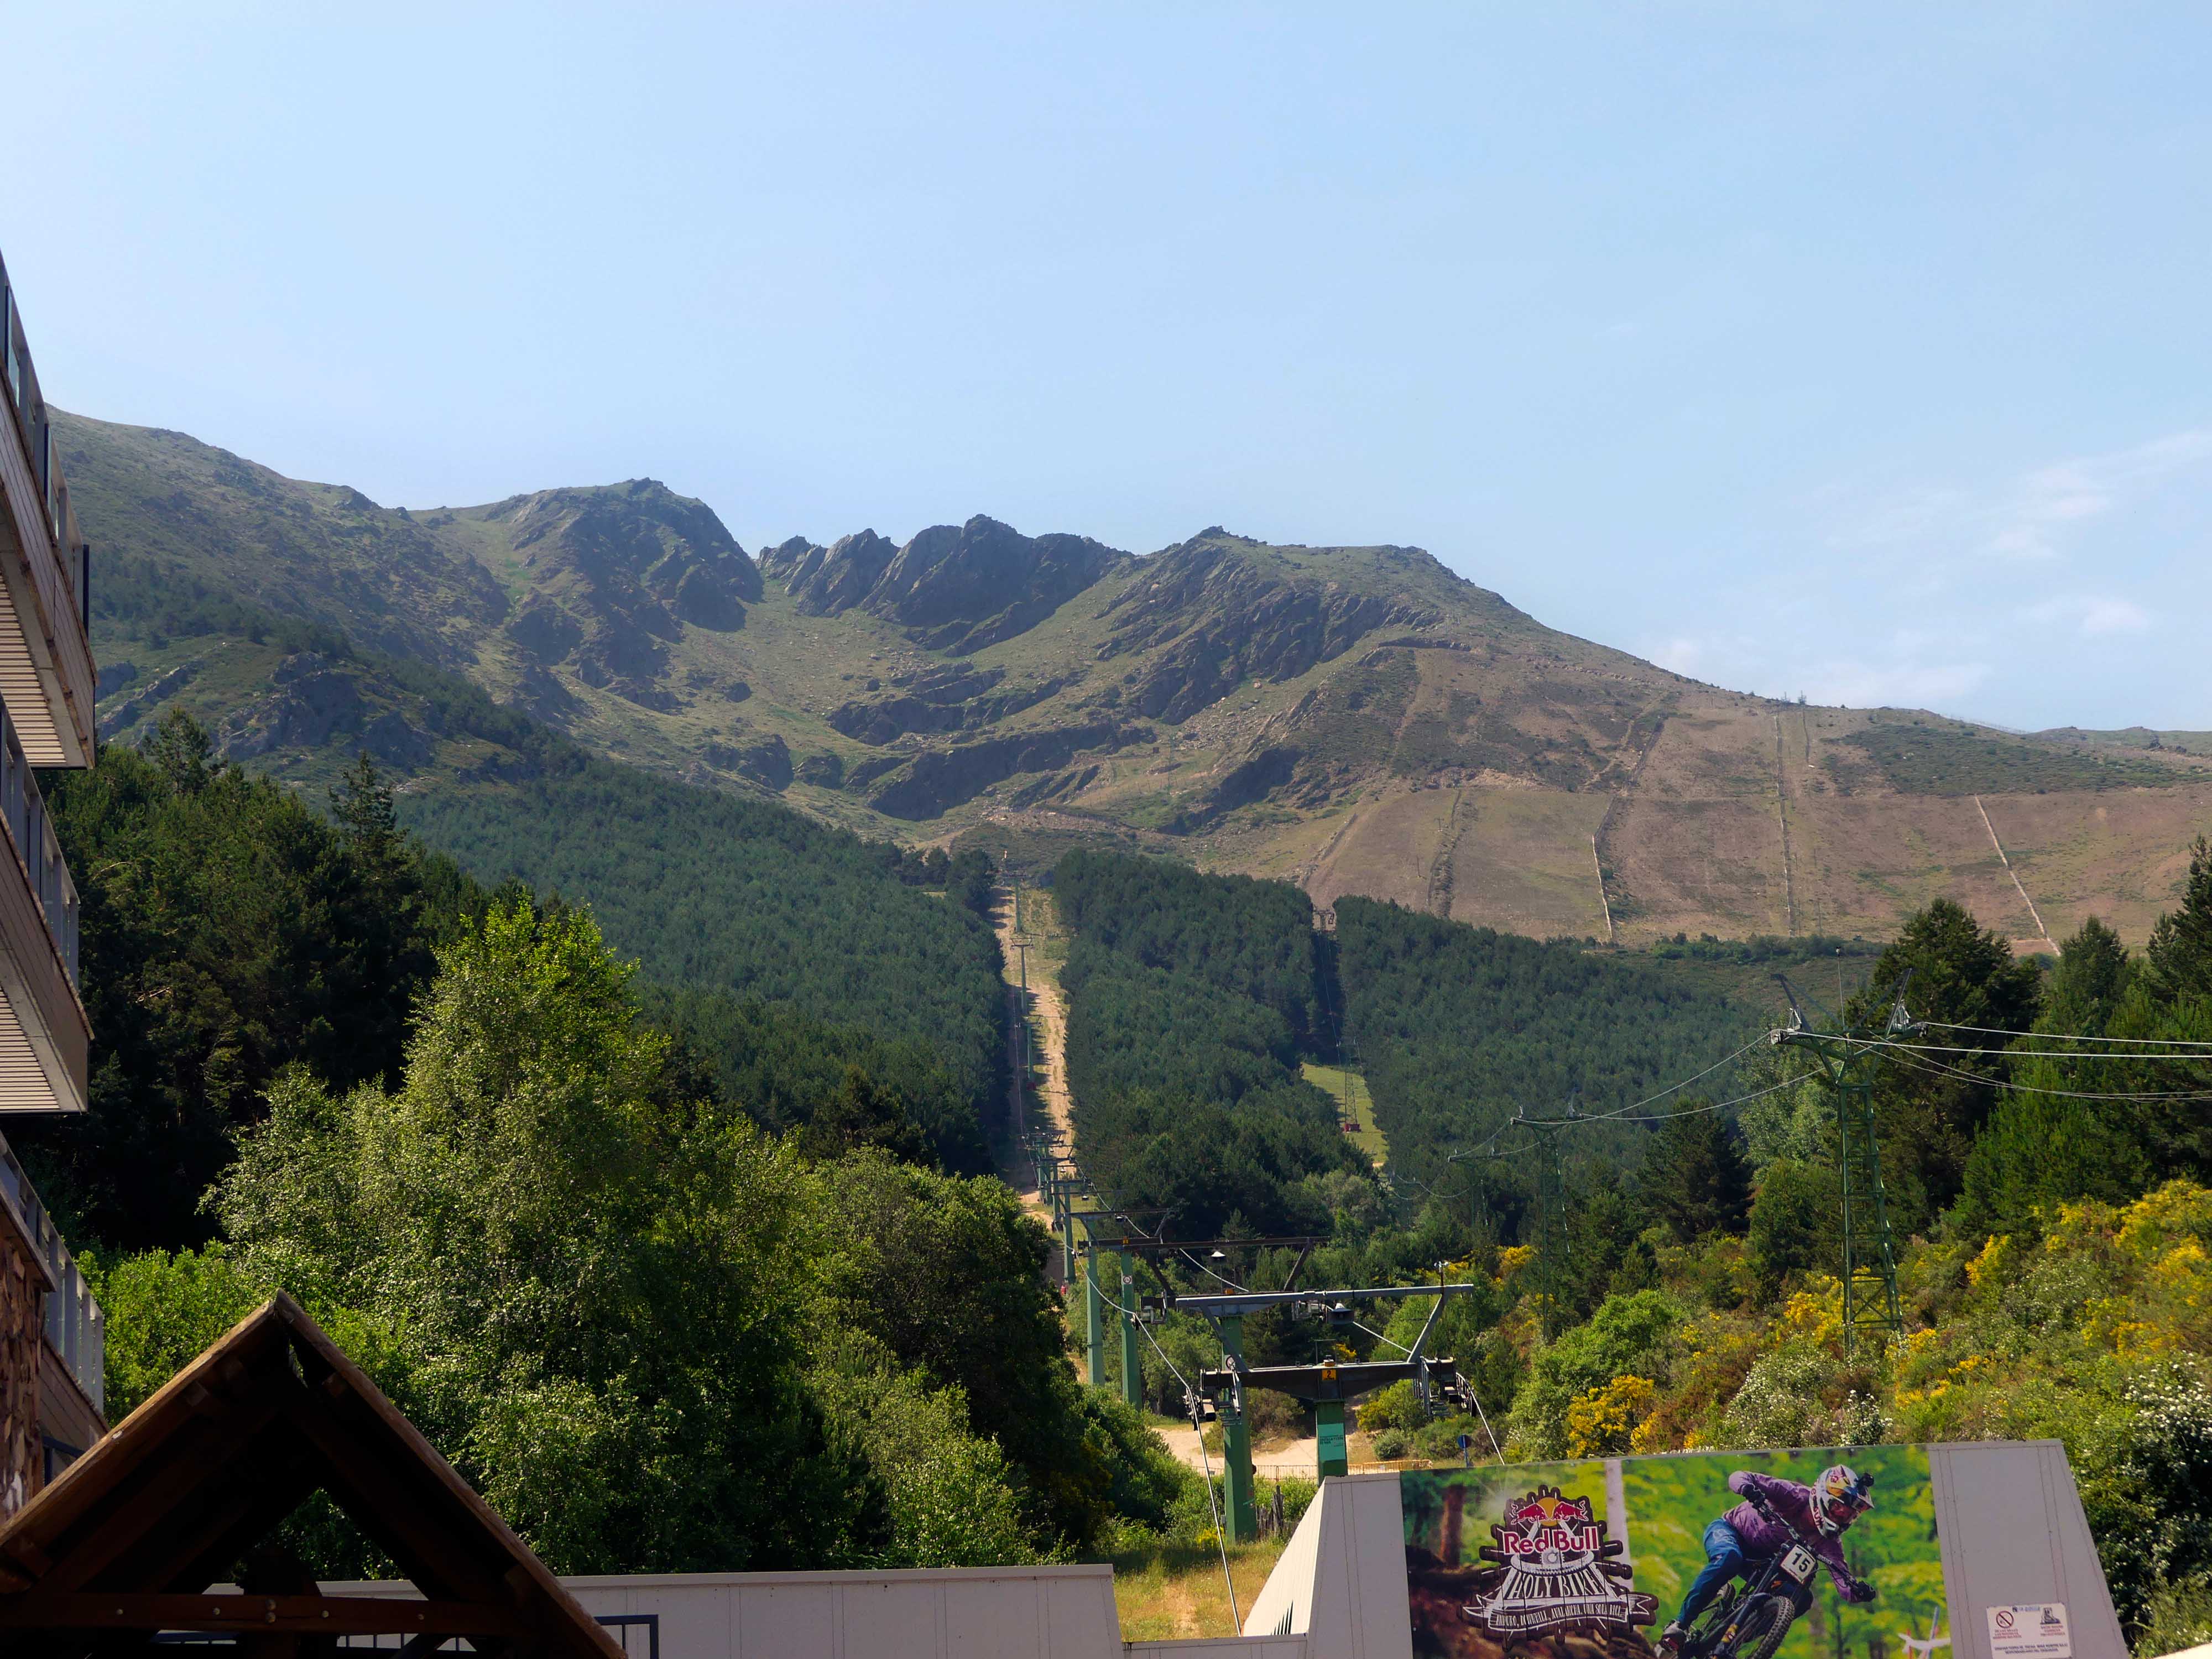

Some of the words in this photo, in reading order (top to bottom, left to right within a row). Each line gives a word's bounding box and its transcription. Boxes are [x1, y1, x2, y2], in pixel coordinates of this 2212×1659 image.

[1503, 1528, 1550, 1555] Red
[1552, 1526, 1599, 1552] Bull
[1792, 1552, 1811, 1572] 15
[1507, 1571, 1553, 1599] HOLY
[1556, 1568, 1605, 1598] BIKE
[1595, 1603, 1608, 1615] SOLA
